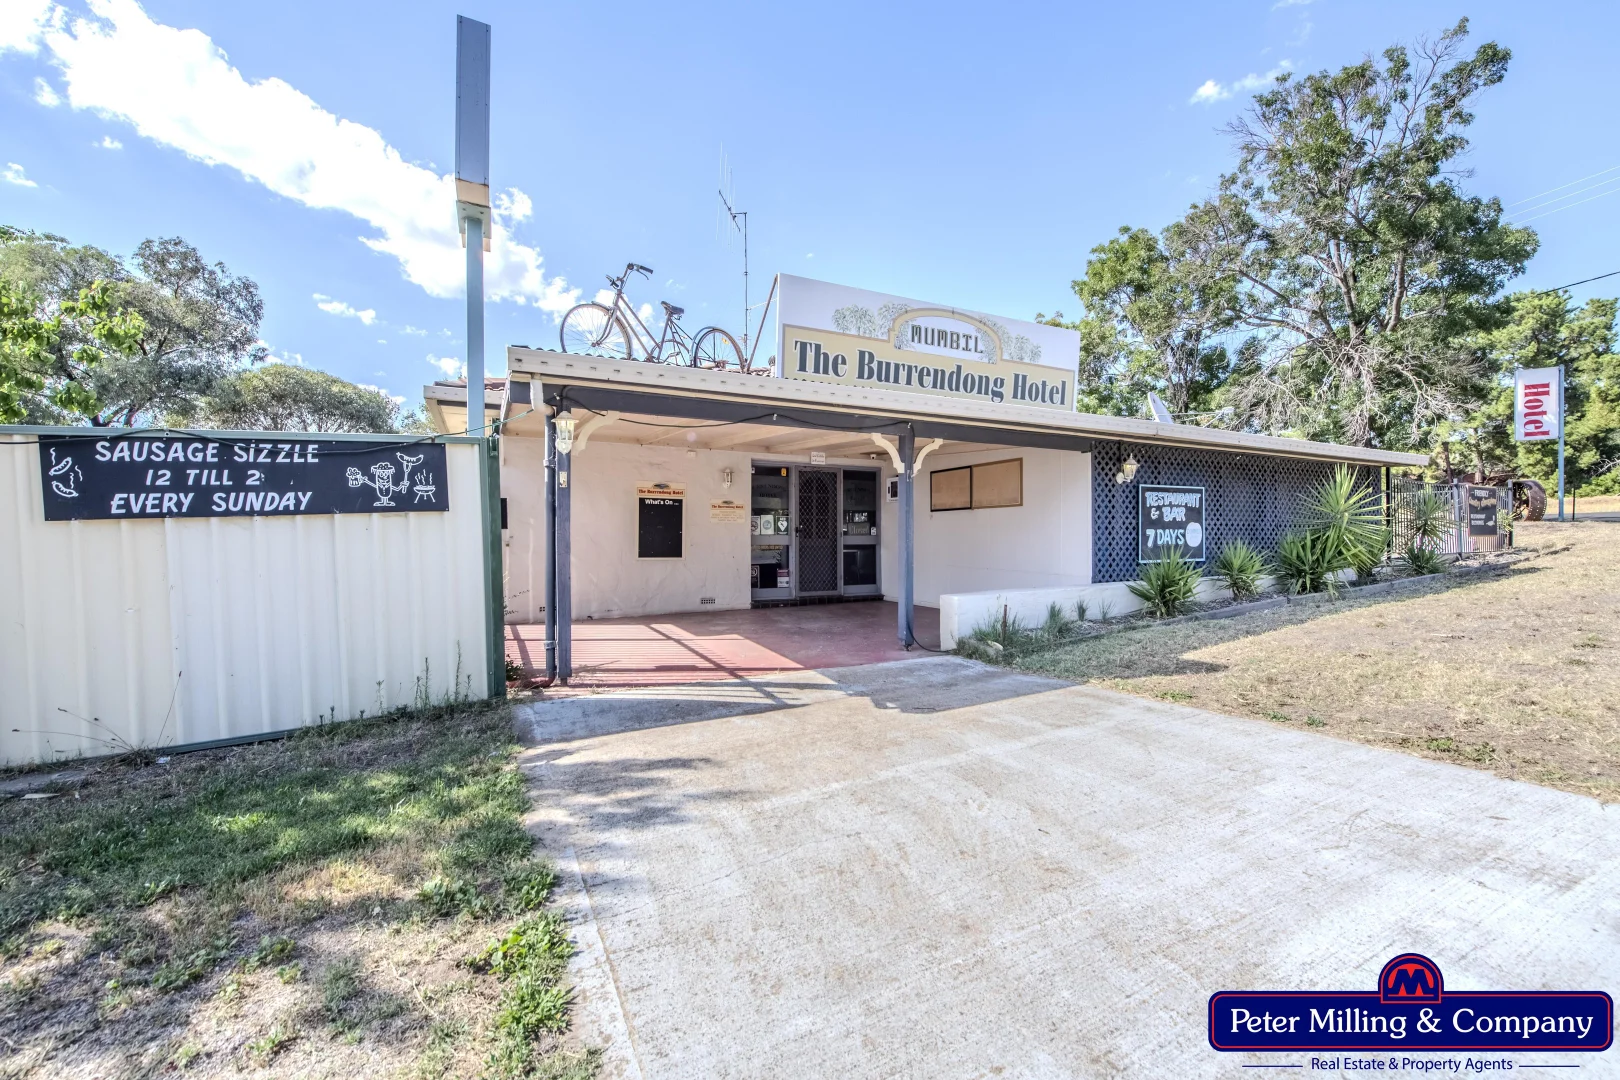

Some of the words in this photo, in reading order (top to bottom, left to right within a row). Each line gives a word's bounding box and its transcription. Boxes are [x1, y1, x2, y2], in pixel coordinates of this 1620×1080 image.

[911, 323, 983, 354] MUMBIL
[794, 340, 848, 379] The
[855, 349, 1006, 404] Burrendong
[1012, 372, 1067, 406] Hotel
[1524, 382, 1550, 438] Hotel
[95, 441, 220, 463] SAUSAGE
[233, 443, 320, 463] SIZZLE
[145, 469, 172, 486] 12
[186, 469, 233, 486] TILL
[111, 492, 195, 514] EVERY
[211, 491, 313, 512] SUNDAY
[1145, 492, 1200, 507] RESTAURANT
[1151, 508, 1160, 520] &
[1162, 507, 1186, 521] BAR
[1146, 529, 1156, 548] 7
[1157, 528, 1185, 545] DAYS
